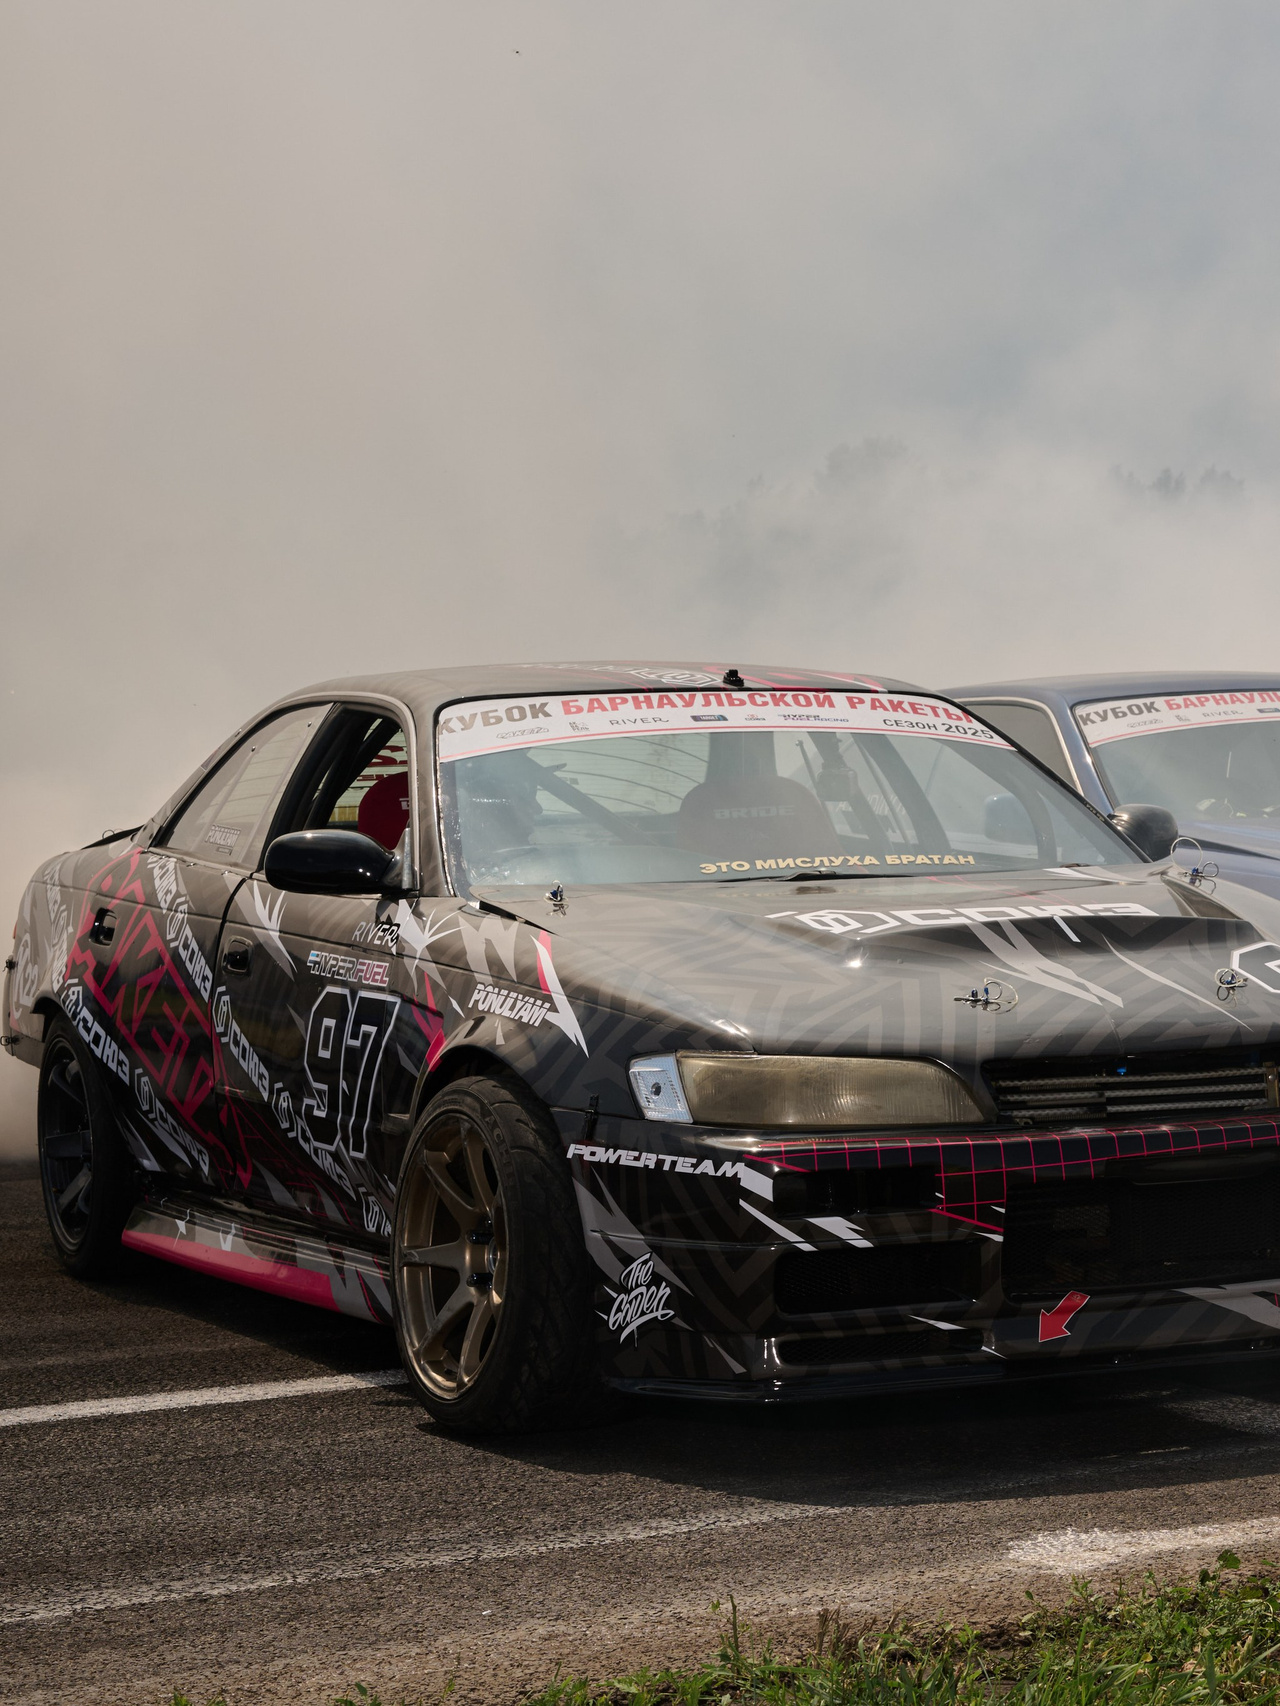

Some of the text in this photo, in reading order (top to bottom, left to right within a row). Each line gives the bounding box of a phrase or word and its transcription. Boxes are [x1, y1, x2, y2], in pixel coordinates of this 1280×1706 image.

[438, 691, 973, 736] КУБОК БАРНАУЛЬСКОЙ РАКЕТЫ
[609, 716, 669, 726] RIVER
[883, 718, 994, 740] СЕЗОН 2025
[1078, 701, 1161, 727] КУБОК
[1202, 709, 1244, 717] RIVER
[713, 804, 796, 820] BRIDE
[699, 854, 976, 875] ЭТО МИСЛУХА БРАТАН
[351, 921, 399, 956] RIVER
[178, 923, 213, 1004] СОЮЗ
[77, 1006, 130, 1086] СОЮЗ
[229, 1019, 270, 1102] СОЮЗ
[302, 985, 402, 1160] 97
[567, 1142, 746, 1179] POWERTEAM
